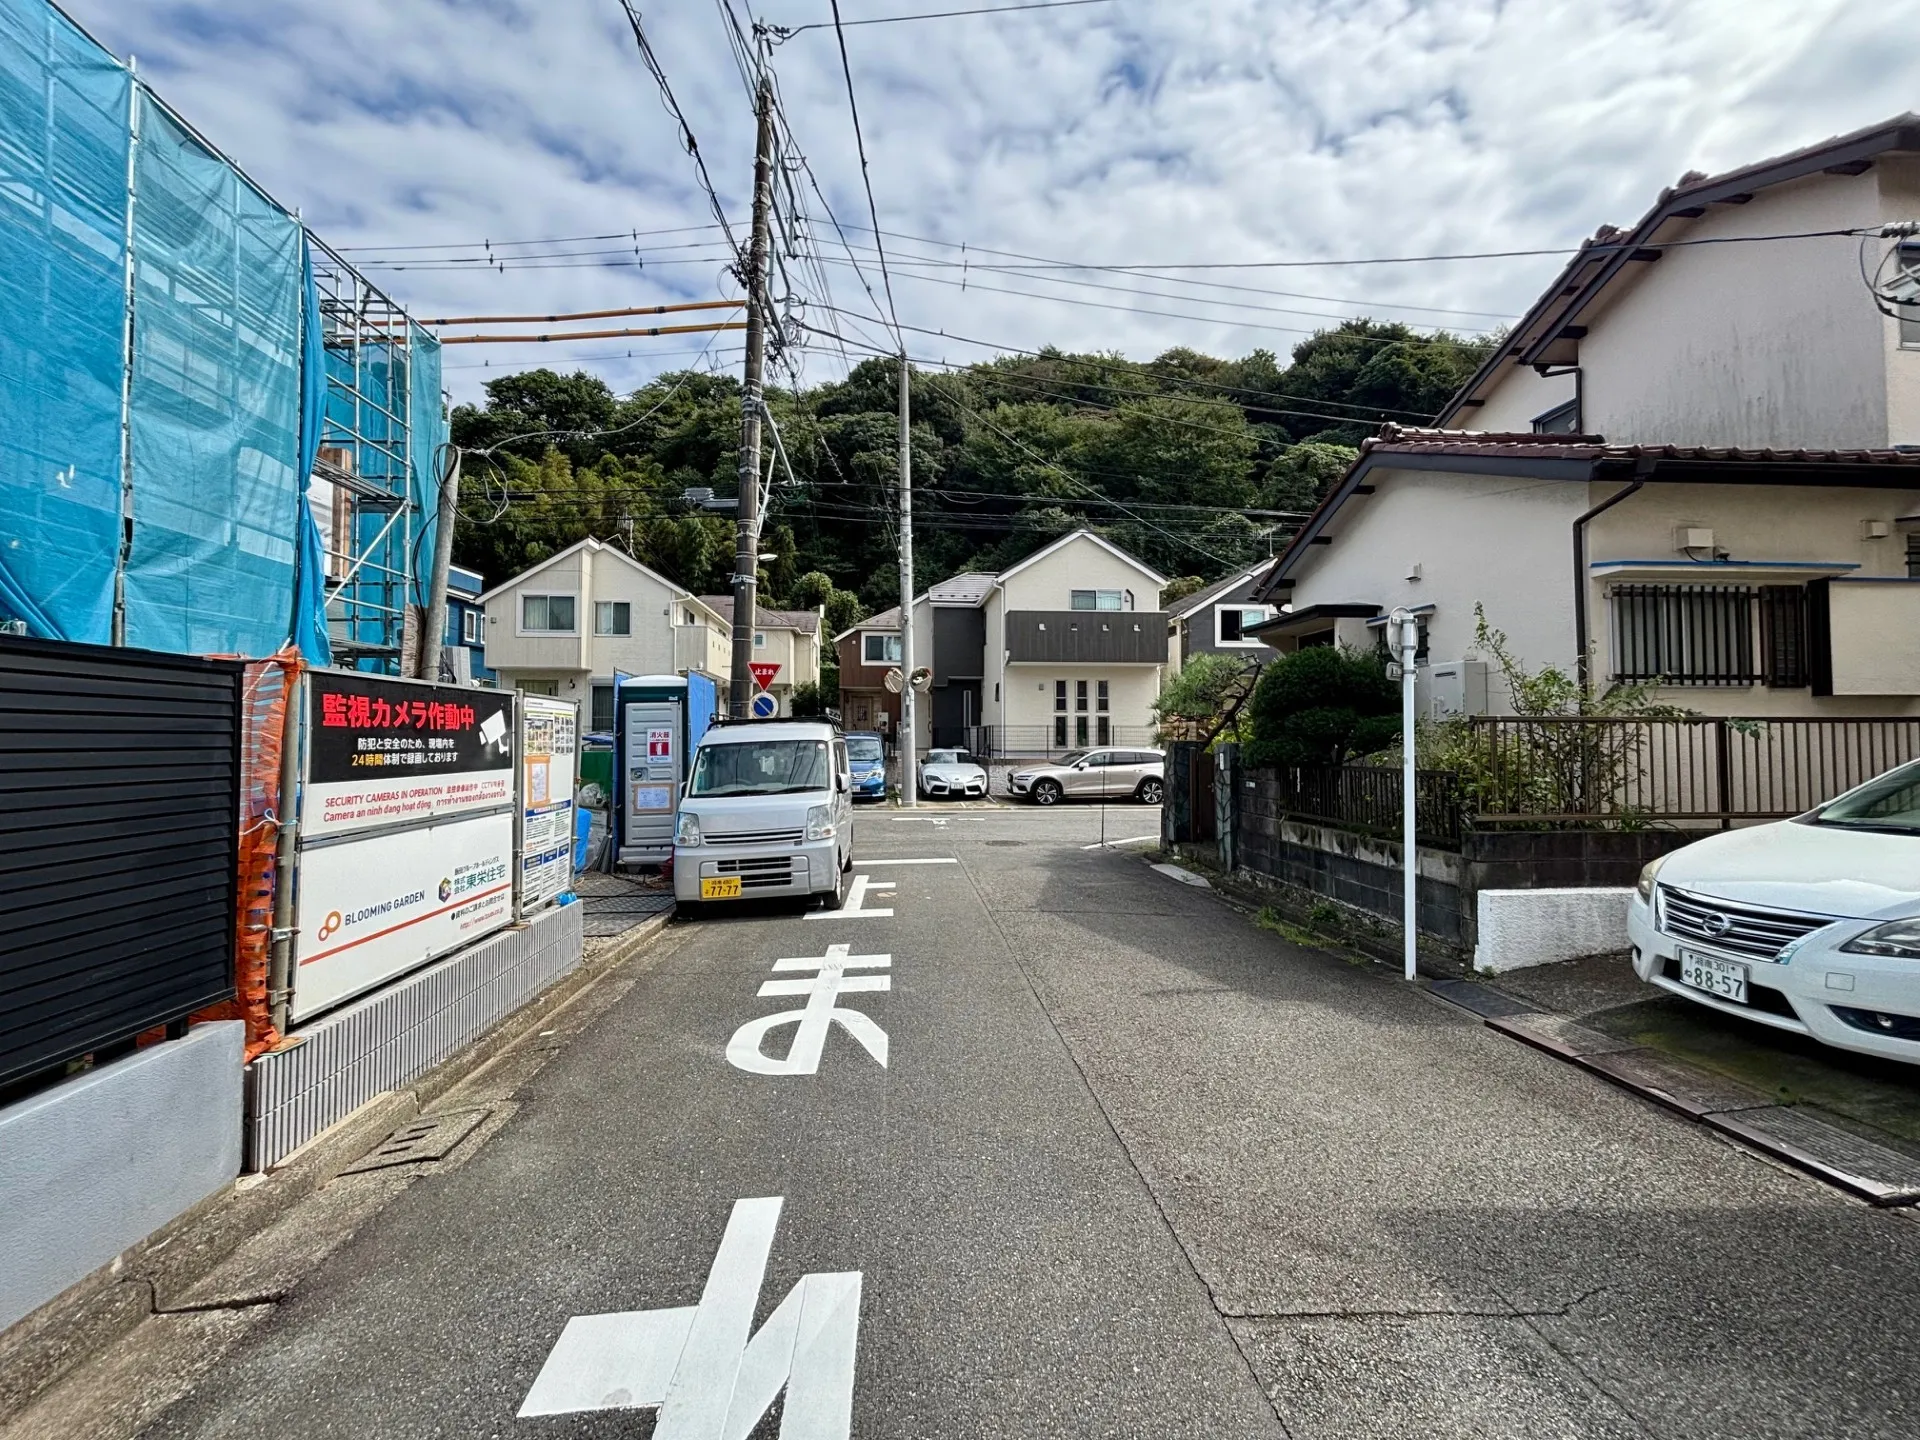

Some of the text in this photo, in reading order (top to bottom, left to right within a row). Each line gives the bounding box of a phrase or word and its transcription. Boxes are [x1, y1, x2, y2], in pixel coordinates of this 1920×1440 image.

[755, 667, 775, 676] 止まれ
[322, 693, 475, 731] 監視カメラ作動中
[650, 731, 670, 739] 消火器
[357, 737, 455, 751] 防犯と安全のため、現場内を
[351, 751, 459, 767] 24時間体制で録画しております
[325, 787, 443, 808] SECURITY CAMERAS IN OPERATION
[323, 811, 354, 823] Camera
[356, 809, 366, 818] an
[367, 805, 383, 816] ninh
[384, 804, 401, 815] đang
[466, 864, 506, 890] 東栄住宅
[711, 885, 738, 896] 77-77
[344, 889, 425, 926] BLOOMING GARDEN
[1713, 961, 1729, 974] 301
[1694, 967, 1742, 998] 88-57
